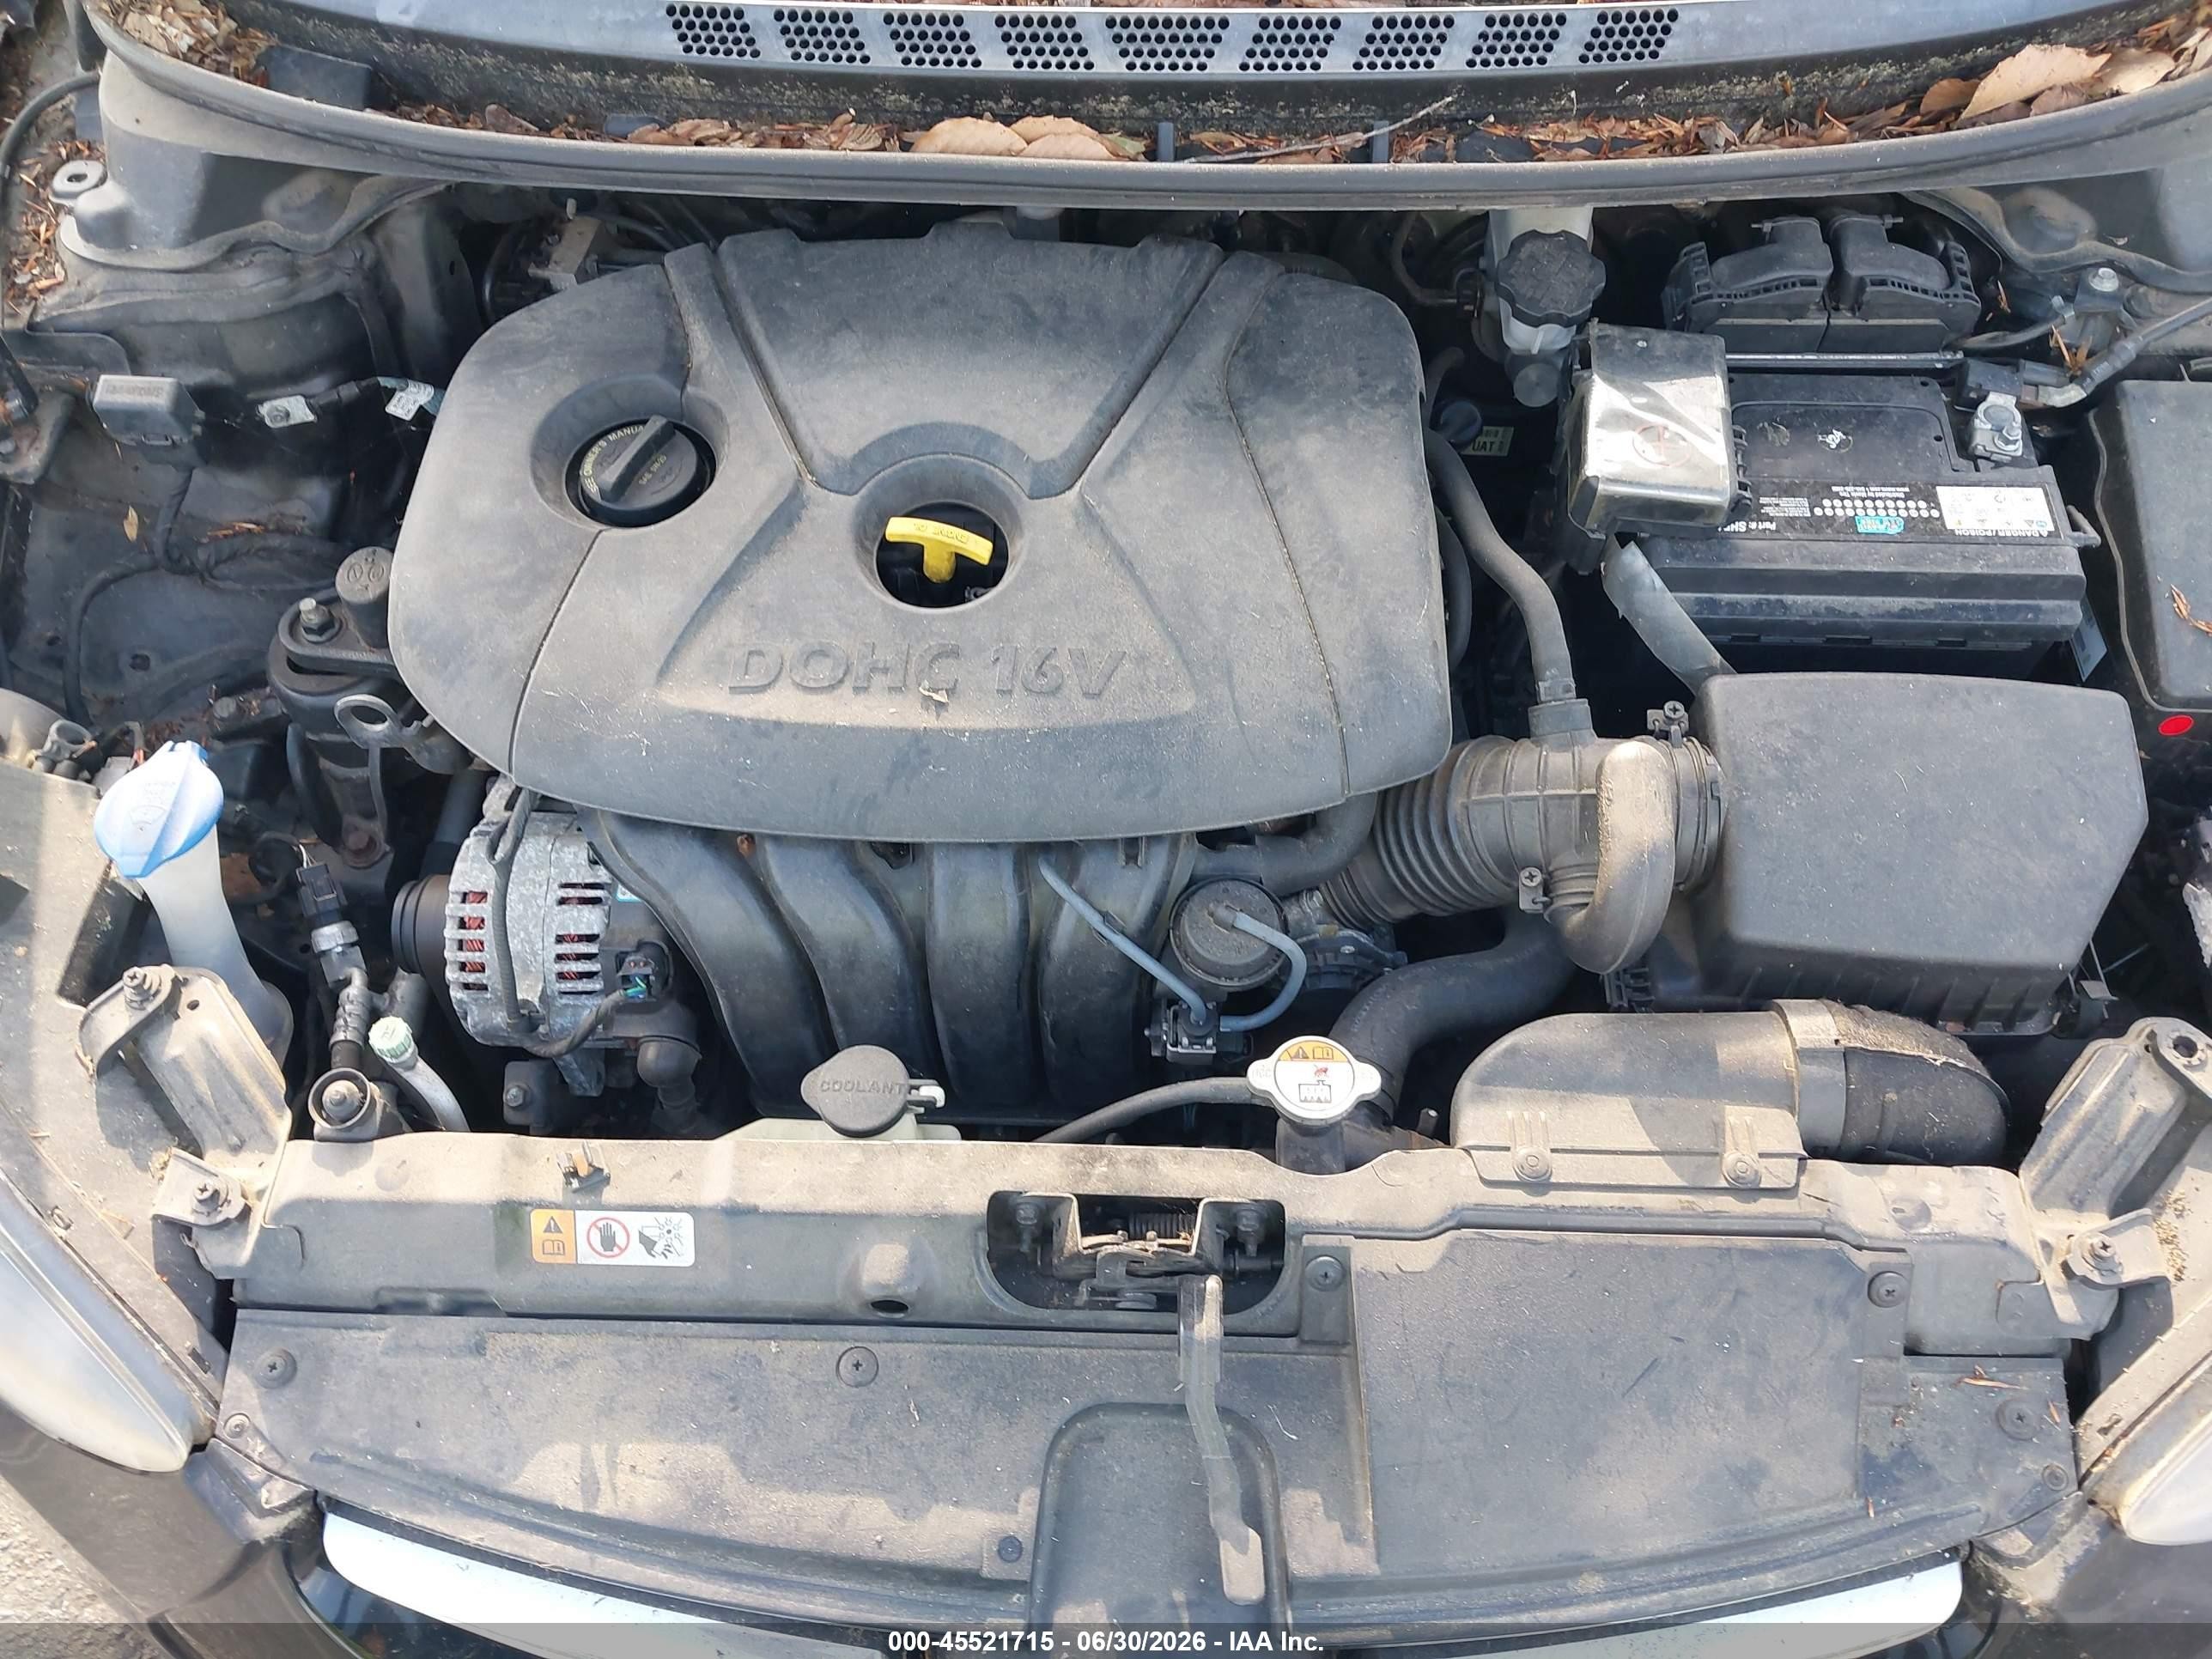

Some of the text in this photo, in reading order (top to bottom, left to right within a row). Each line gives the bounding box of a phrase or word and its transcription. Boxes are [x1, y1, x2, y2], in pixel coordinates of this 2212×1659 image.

[608, 425, 645, 442] MANUA
[728, 641, 1127, 700] DOHC 16V
[820, 1079, 904, 1096] COOLANT
